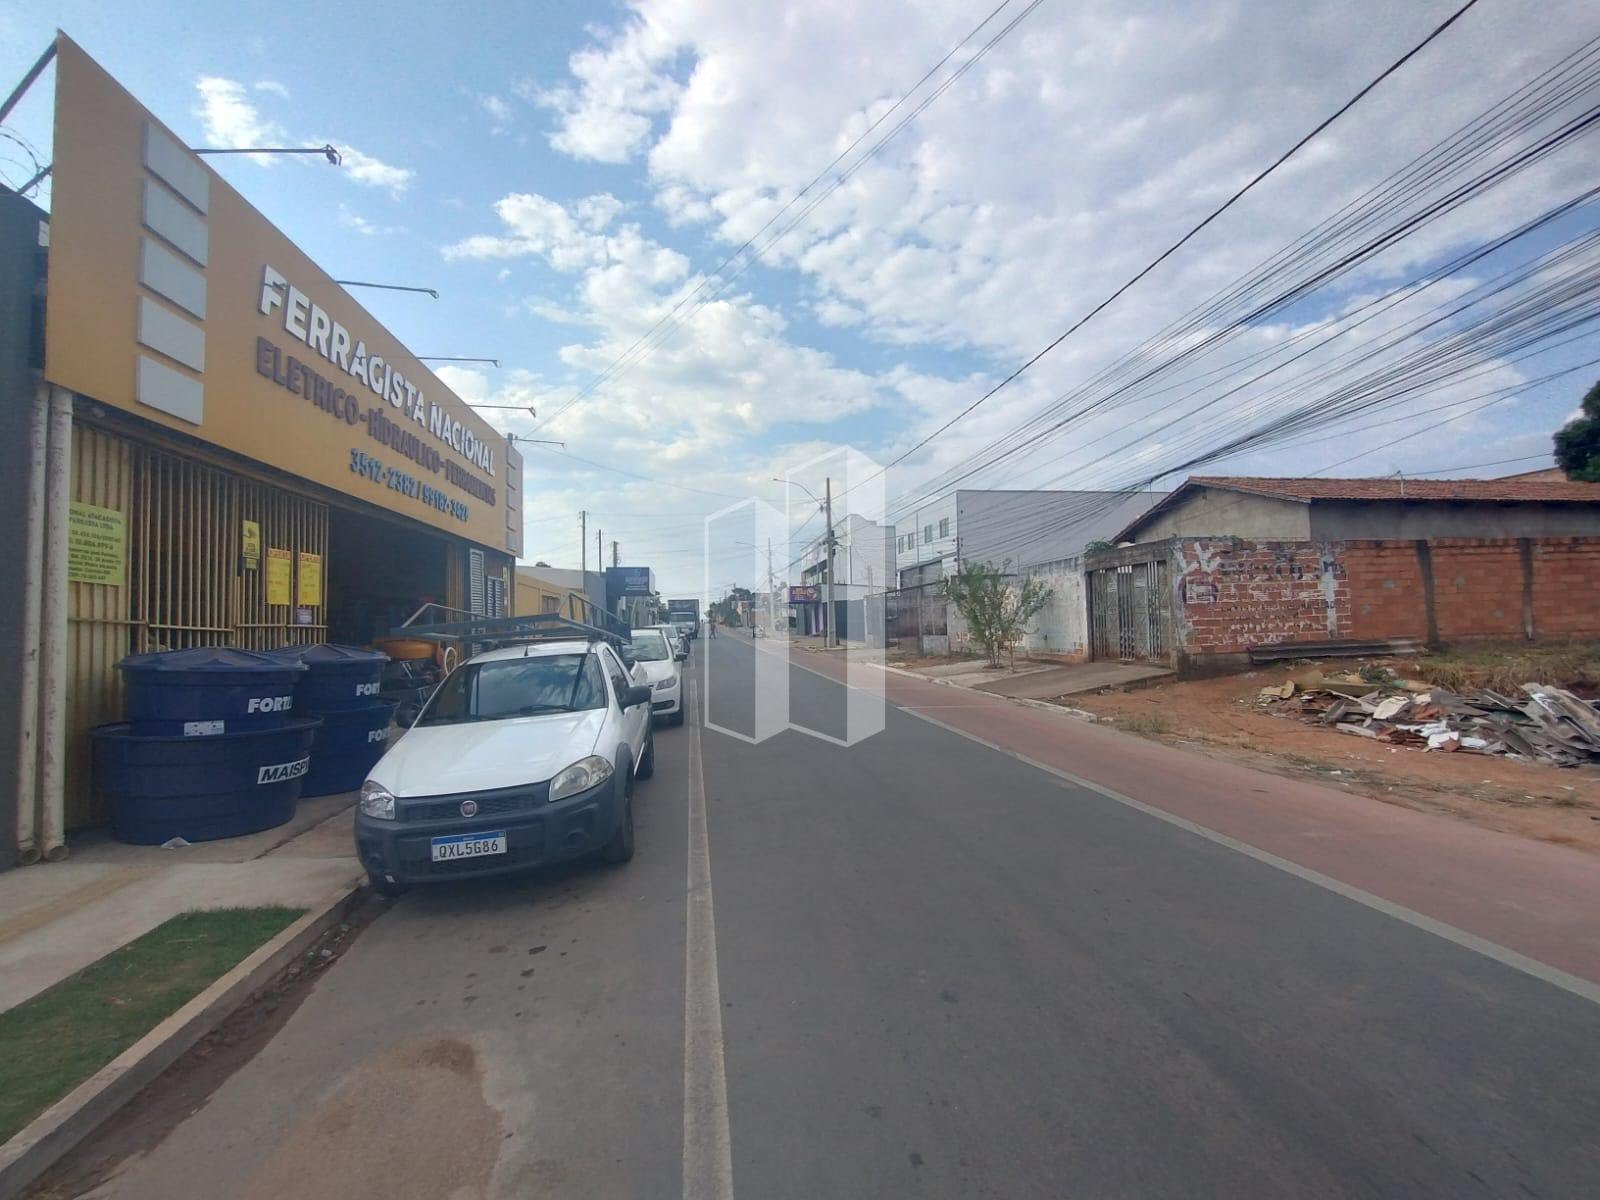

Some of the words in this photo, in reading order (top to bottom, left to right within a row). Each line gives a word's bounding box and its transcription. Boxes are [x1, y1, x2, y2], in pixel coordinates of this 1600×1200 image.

[259, 264, 425, 428] FERRAGISTA
[428, 401, 496, 478] NACIONAL
[439, 839, 499, 858] QXL5G86
